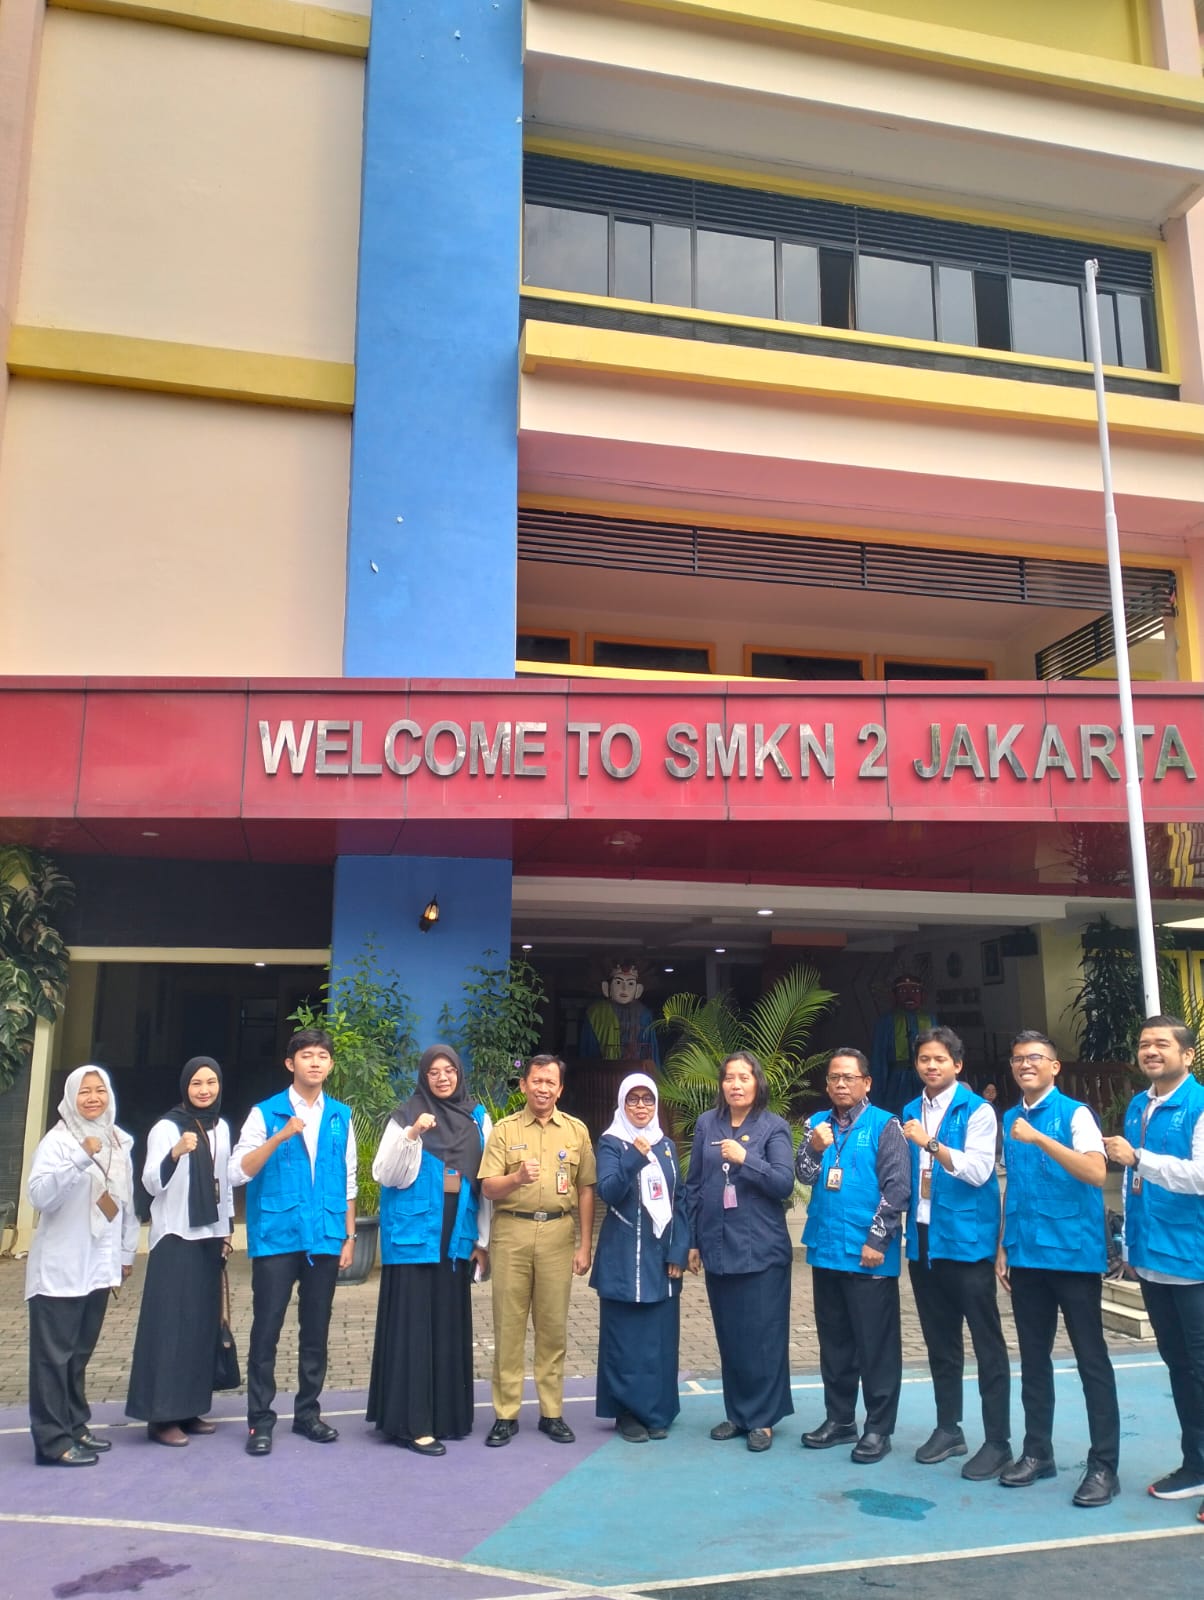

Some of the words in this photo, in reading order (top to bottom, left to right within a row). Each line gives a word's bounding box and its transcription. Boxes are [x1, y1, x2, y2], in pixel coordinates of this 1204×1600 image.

[258, 719, 548, 777] WELCOME
[567, 722, 642, 778] TO
[664, 722, 835, 778] SMKN
[857, 723, 888, 778] 2
[913, 724, 1197, 779] JAKARTA
